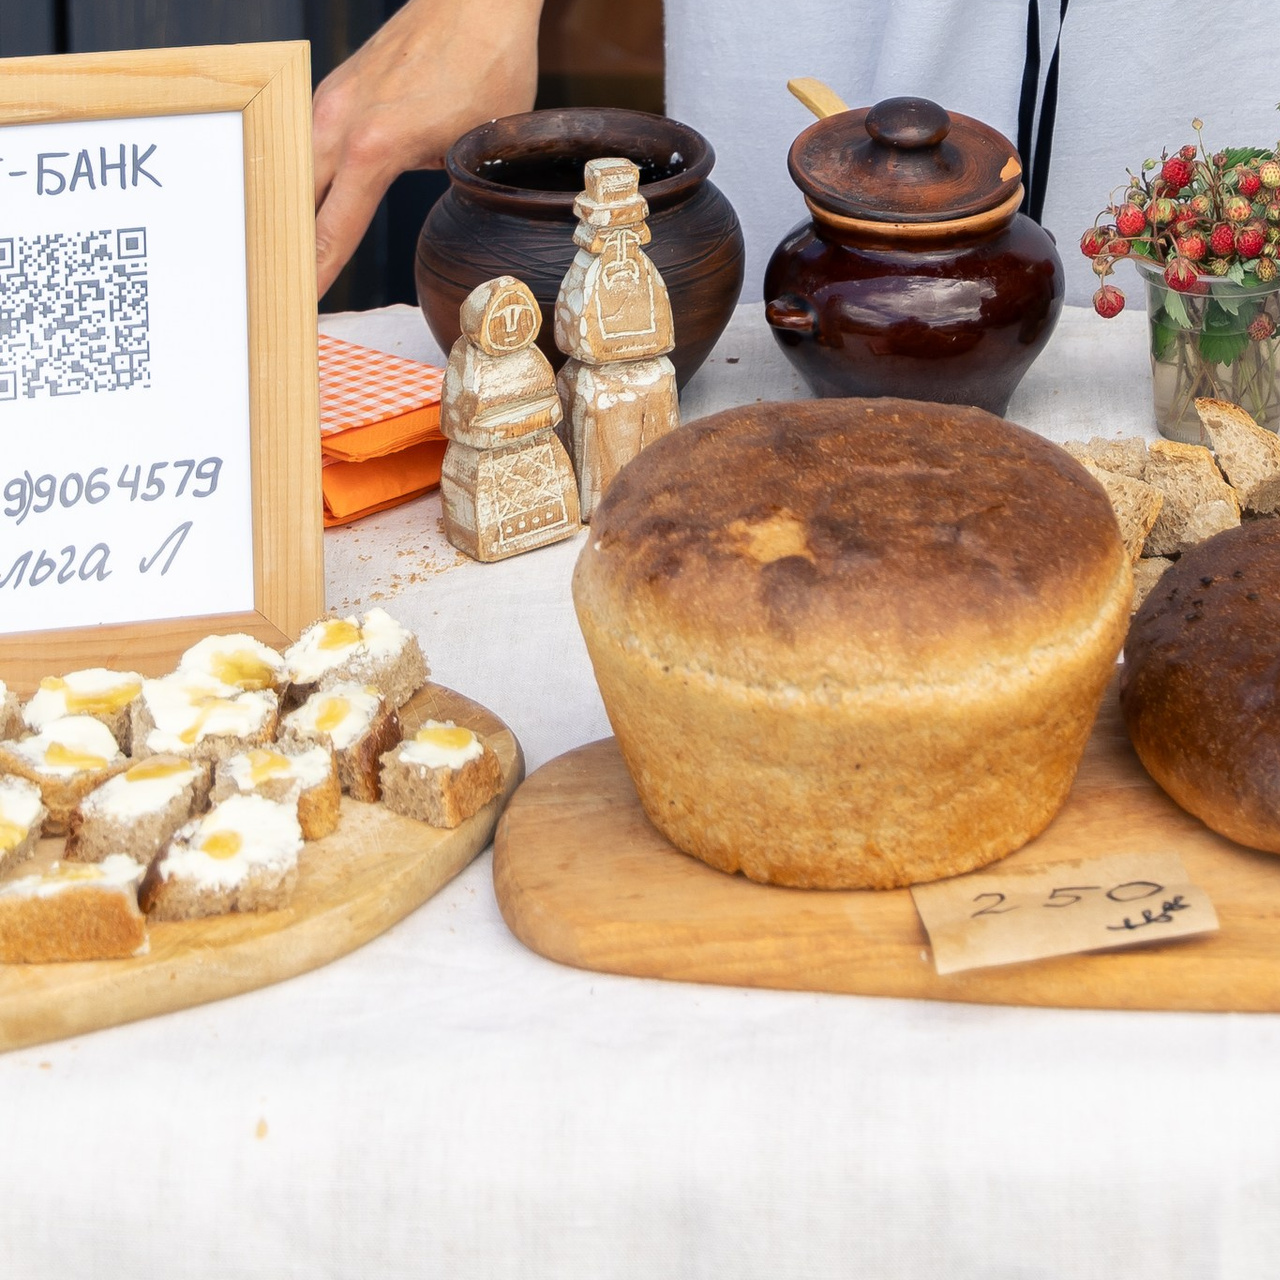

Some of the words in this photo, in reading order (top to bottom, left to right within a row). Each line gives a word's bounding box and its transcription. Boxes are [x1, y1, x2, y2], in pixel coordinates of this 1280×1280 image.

[0, 143, 163, 196] -БАНК
[139, 520, 193, 576] Л
[970, 881, 1165, 919] 250
